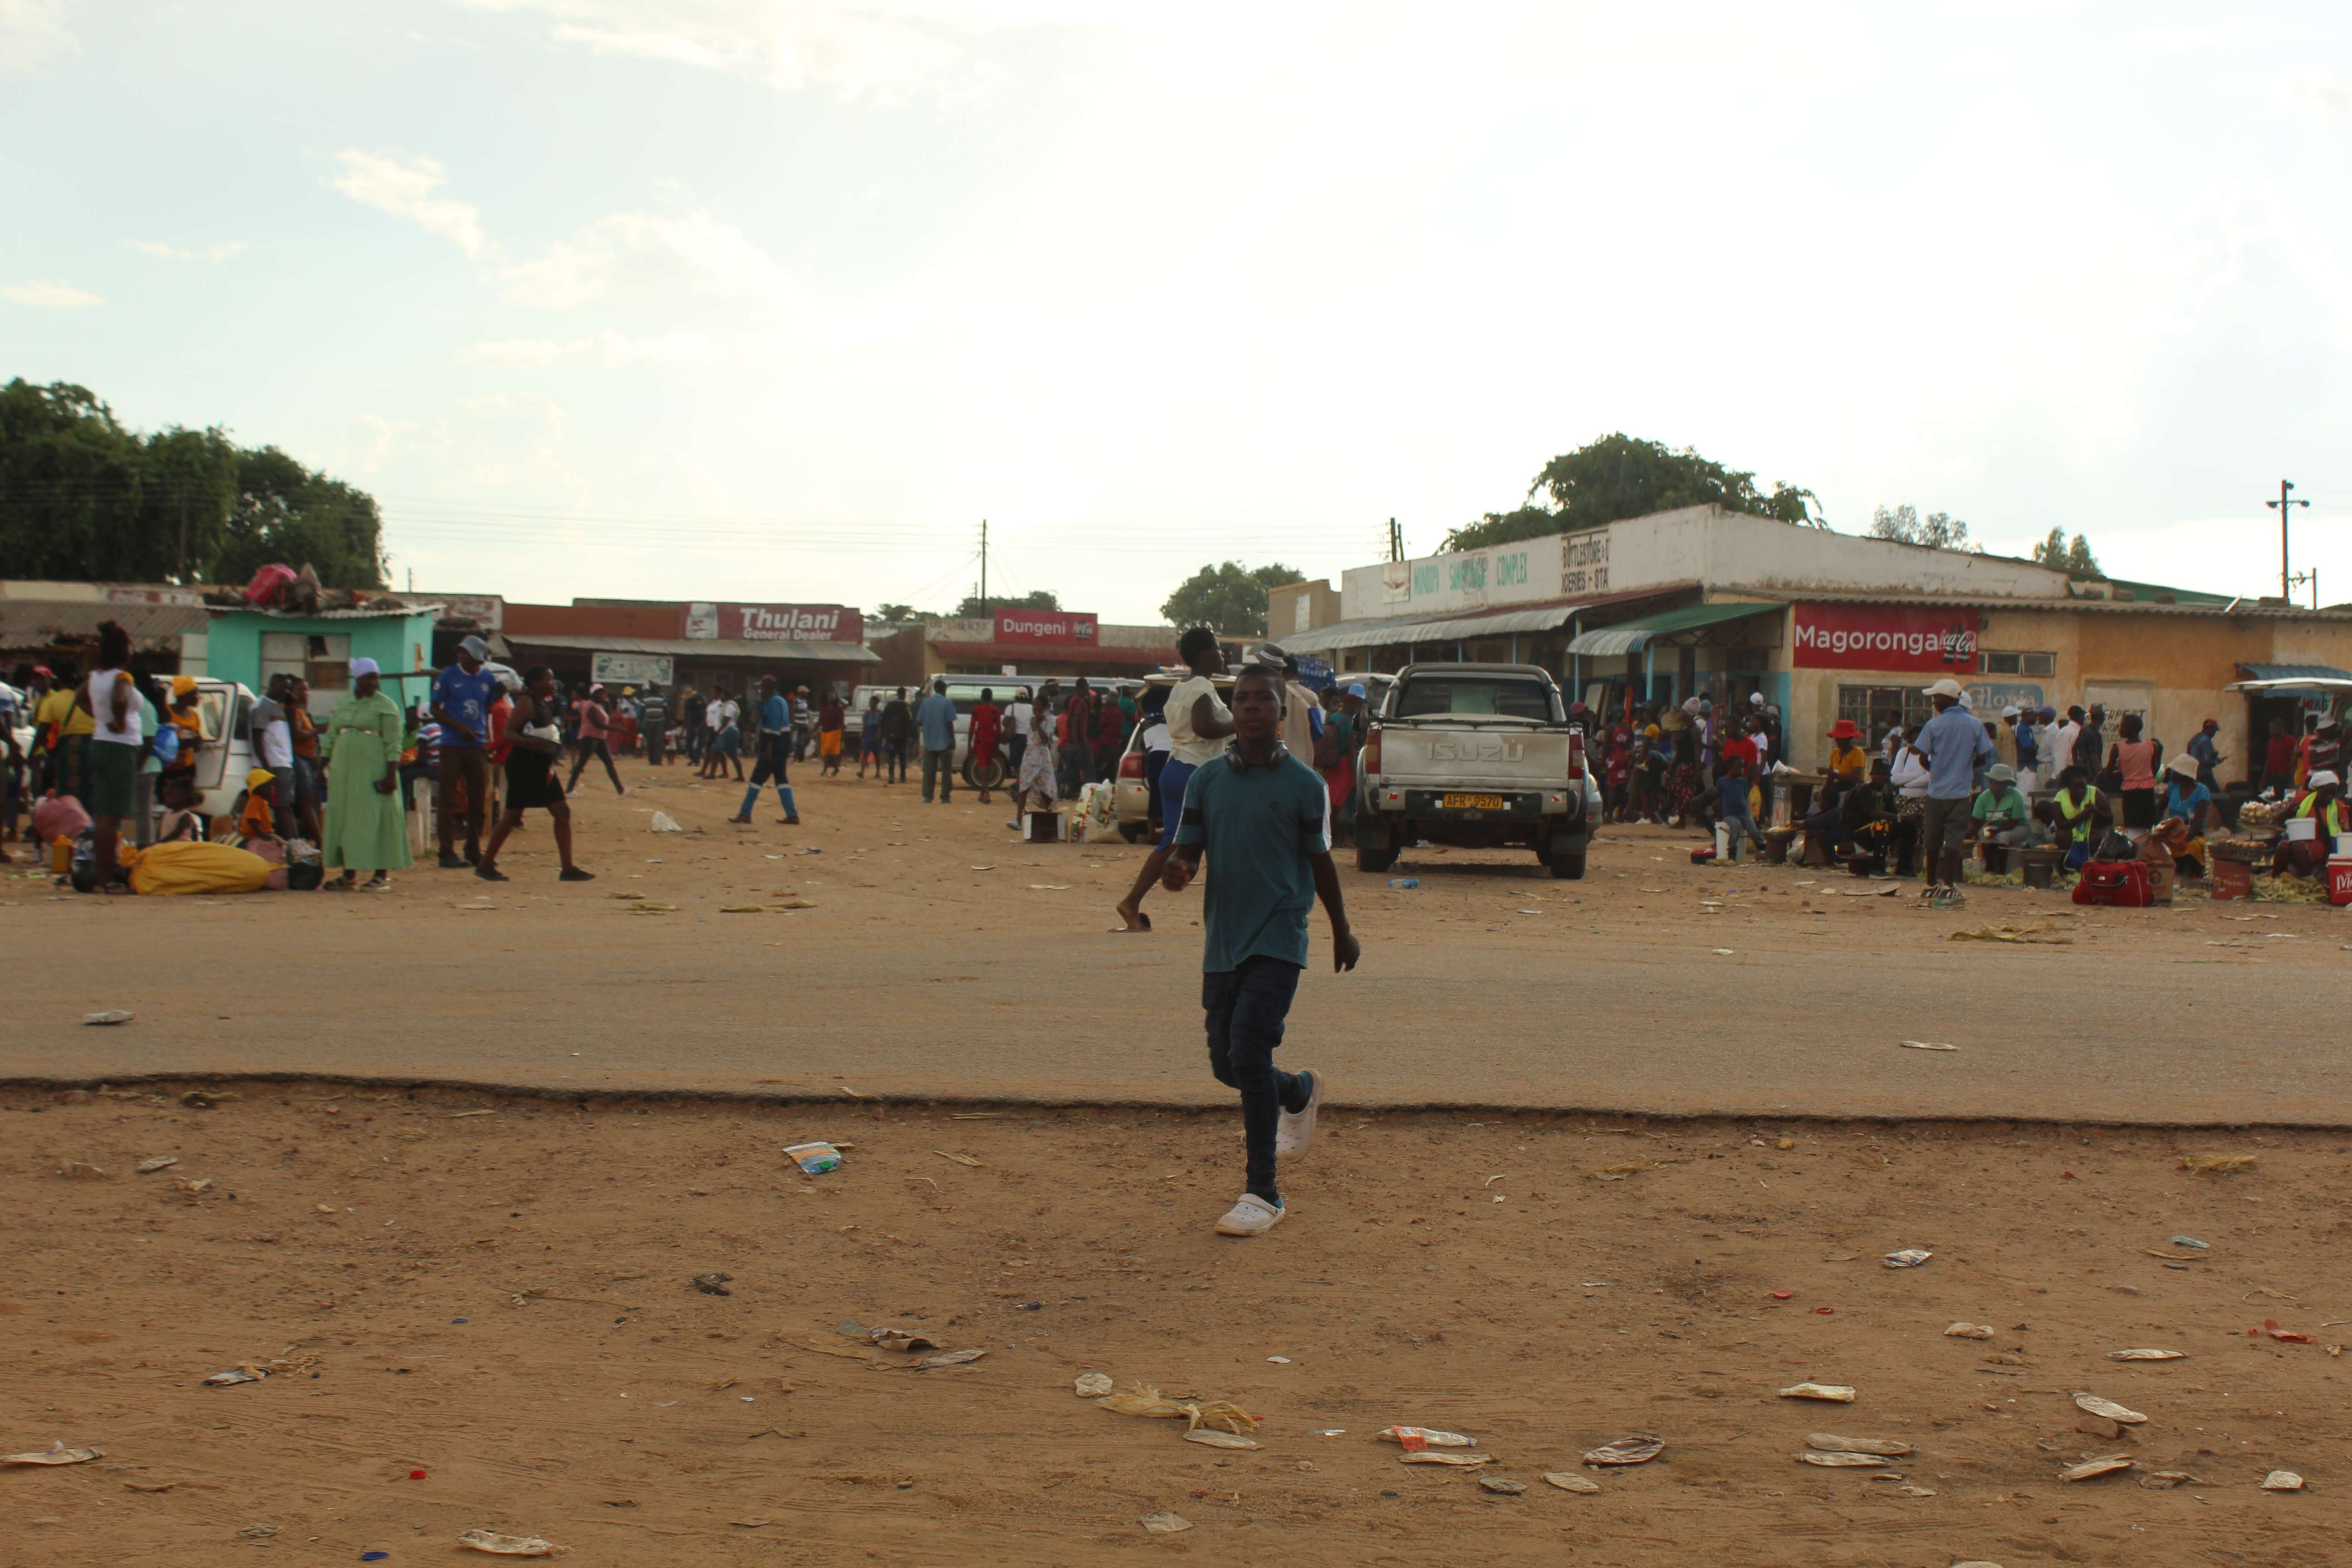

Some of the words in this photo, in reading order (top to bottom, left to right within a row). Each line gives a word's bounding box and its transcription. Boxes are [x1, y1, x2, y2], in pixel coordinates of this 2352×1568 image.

[1563, 540, 1601, 568] BOTTLESTORE
[1497, 551, 1528, 586] COMPLEX
[1594, 567, 1609, 589] STA
[740, 607, 840, 629] Thulani
[1003, 619, 1066, 636] Dungeni
[743, 628, 790, 639] General
[794, 629, 832, 640] Dealer
[1795, 625, 1938, 656] Magoronga
[1427, 742, 1524, 763] ISUZU
[1446, 795, 1465, 807] AFR
[1474, 796, 1500, 808] 9570
